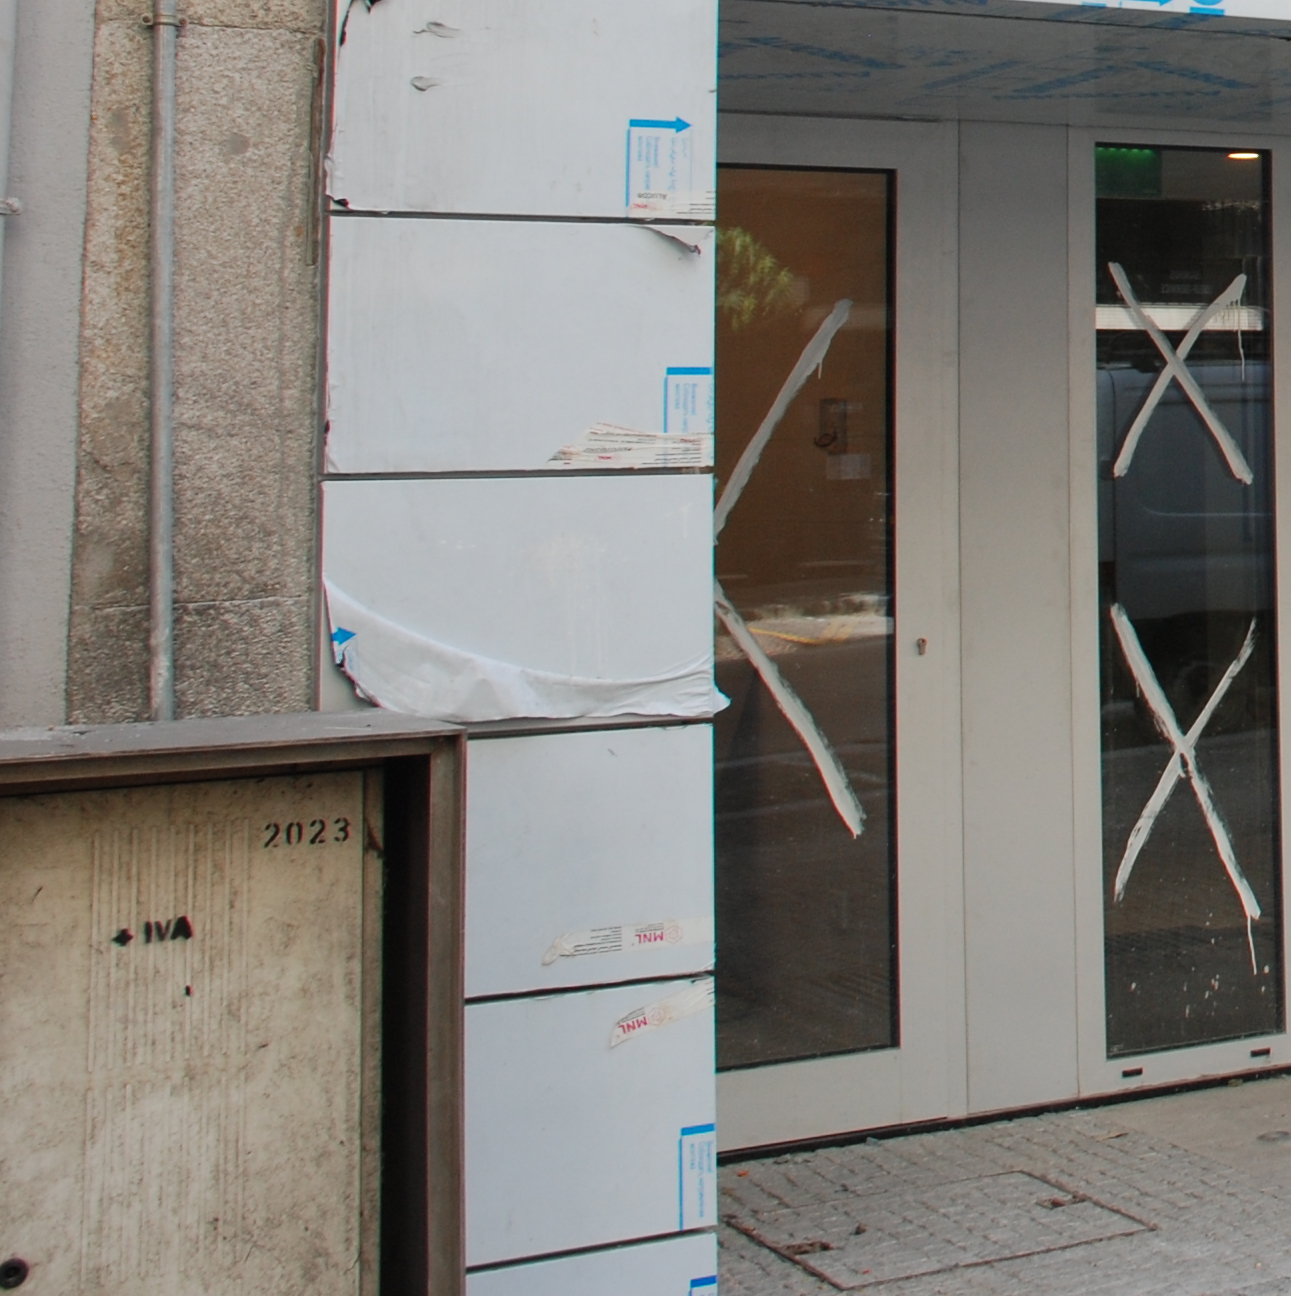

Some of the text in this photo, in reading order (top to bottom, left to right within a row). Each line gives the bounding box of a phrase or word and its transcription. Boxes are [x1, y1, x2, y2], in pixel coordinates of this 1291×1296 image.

[264, 817, 351, 849] 2023
[144, 915, 194, 944] IVA
[635, 931, 665, 945] MNL
[618, 1016, 649, 1035] MNL
